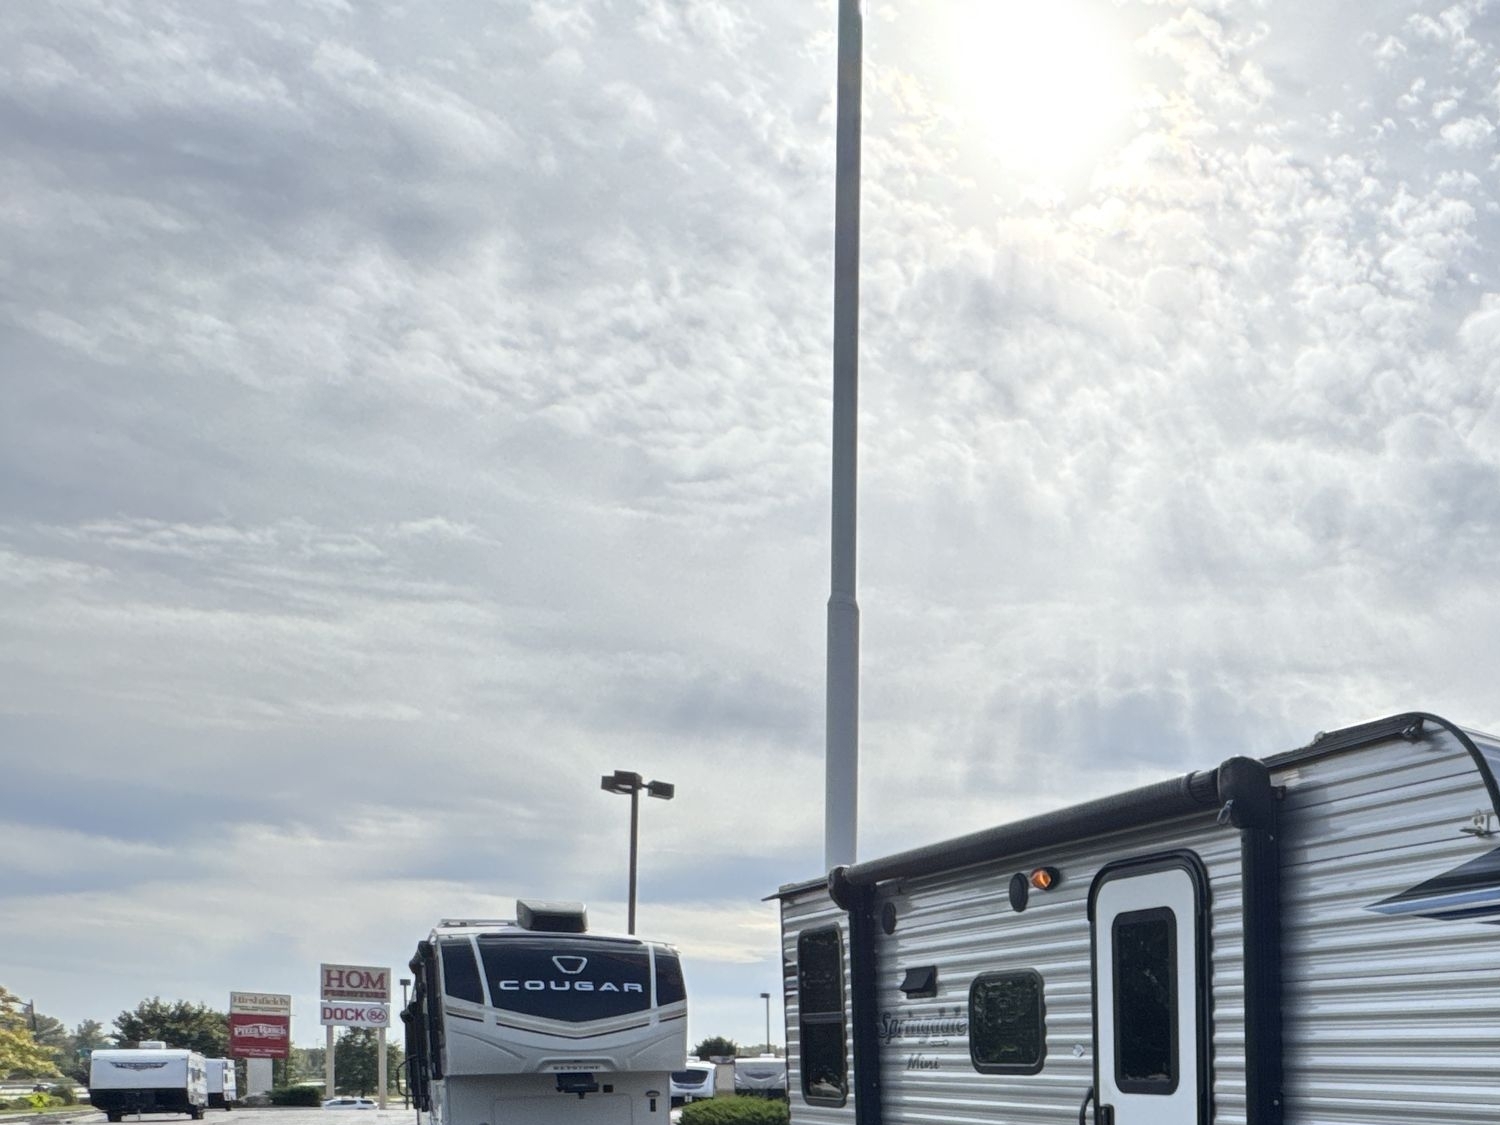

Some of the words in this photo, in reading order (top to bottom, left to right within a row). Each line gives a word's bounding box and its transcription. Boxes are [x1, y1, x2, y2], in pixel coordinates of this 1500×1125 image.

[324, 969, 386, 990] HOM
[499, 980, 643, 993] COUGAR
[323, 1007, 366, 1021] DOCK
[907, 1053, 940, 1070] Mini
